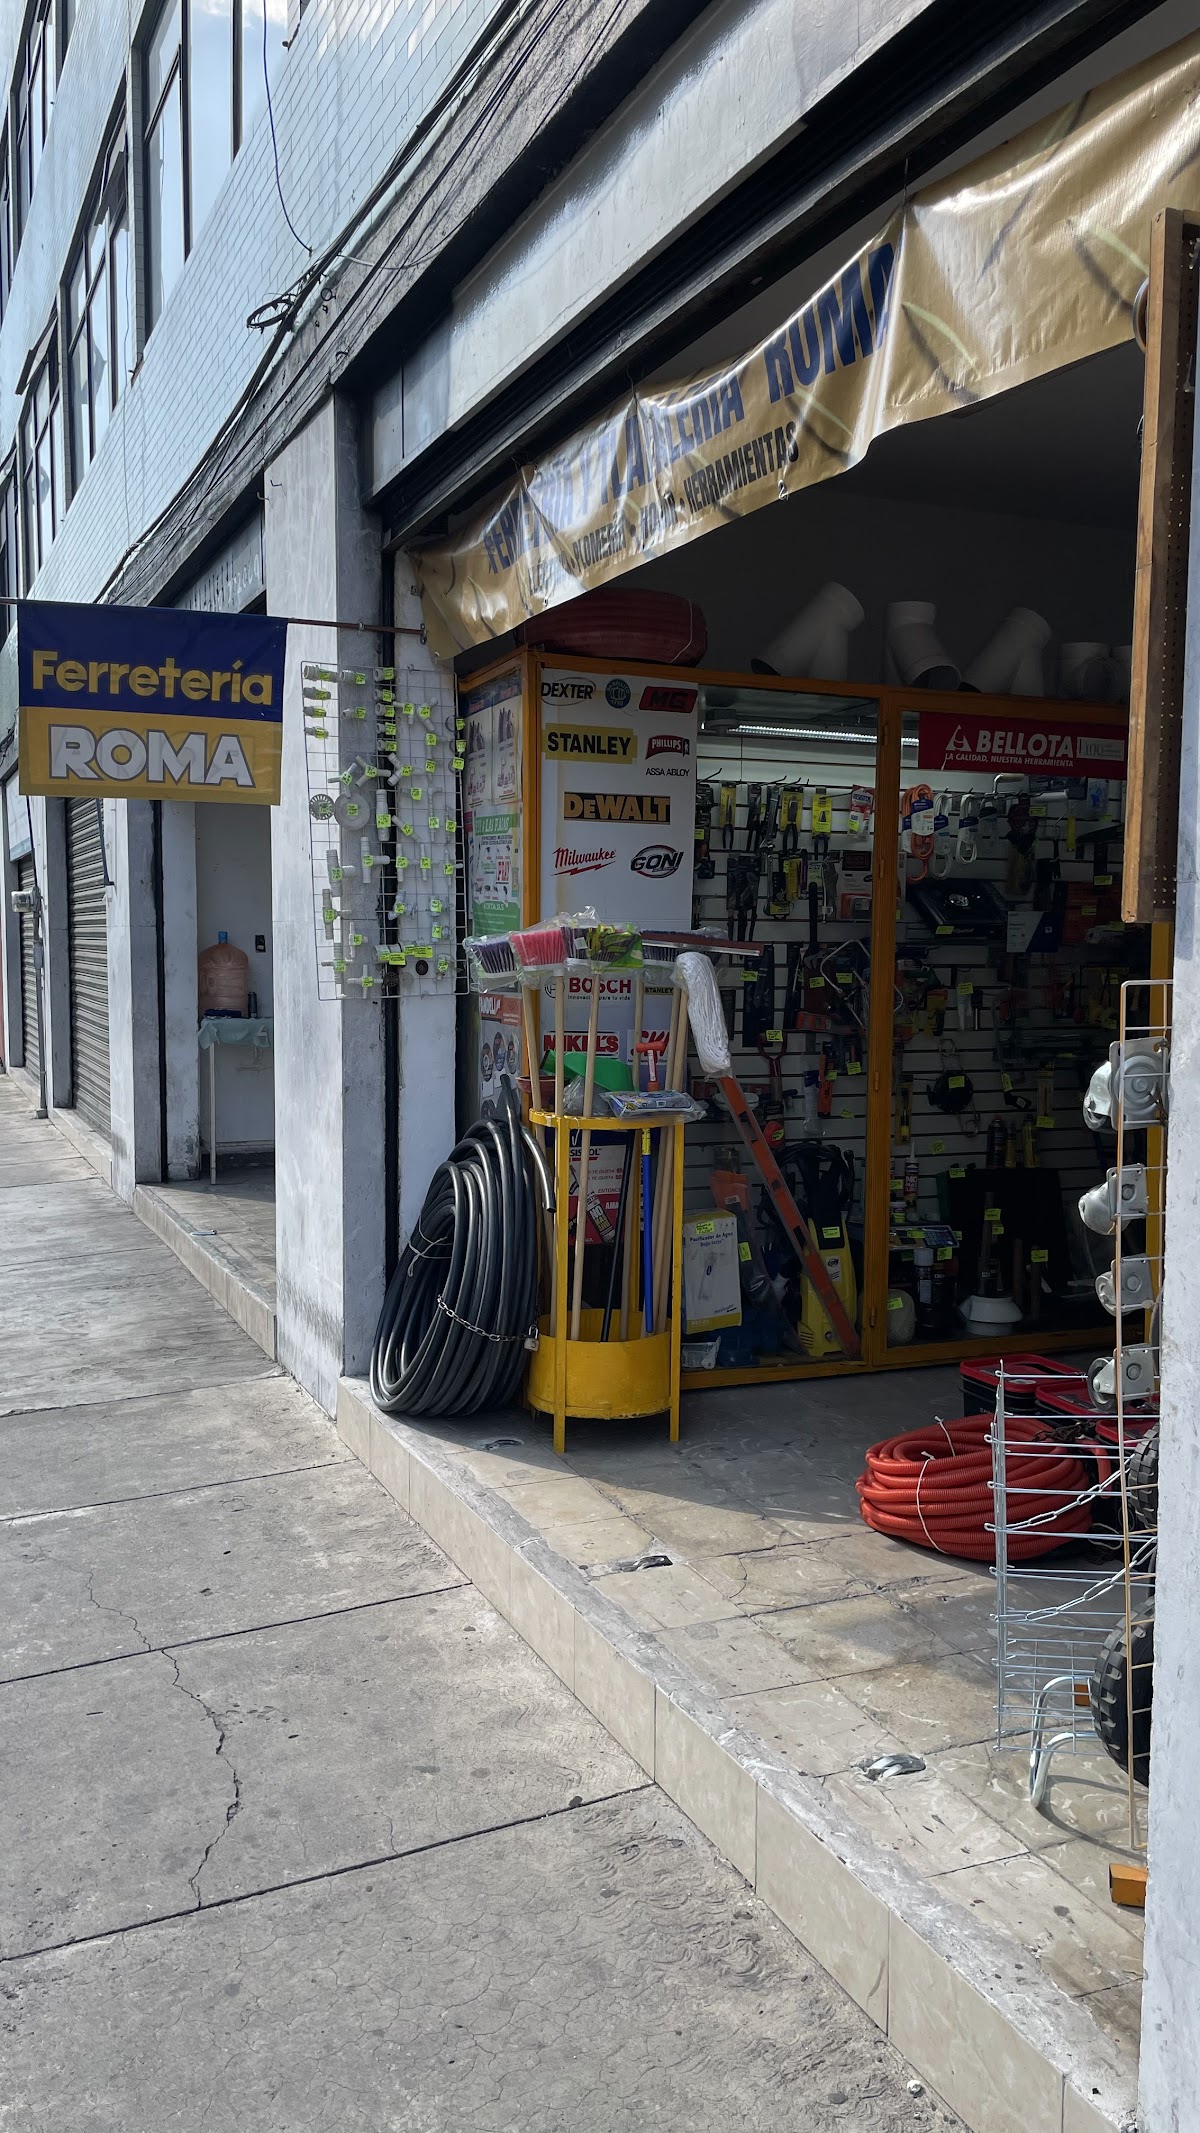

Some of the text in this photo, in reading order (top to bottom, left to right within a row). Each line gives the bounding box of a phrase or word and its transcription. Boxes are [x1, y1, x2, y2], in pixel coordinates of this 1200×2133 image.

[684, 421, 799, 514] HERRAMIENTAS
[32, 651, 272, 706] Ferretería
[541, 682, 593, 699] DEXTER
[547, 731, 632, 755] STANLEY
[651, 738, 682, 750] PHILLIPS
[976, 730, 1074, 758] BELLOTA
[49, 724, 256, 788] ROMA
[955, 753, 989, 763] CALIDAD,
[990, 755, 1022, 765] NUESTRA
[1024, 757, 1074, 767] HERRAMIENTA
[645, 767, 690, 777] ASSA ABLOY
[552, 847, 616, 869] Milwaukee
[569, 977, 631, 994] BOSCH
[569, 1148, 600, 1157] SISOL
